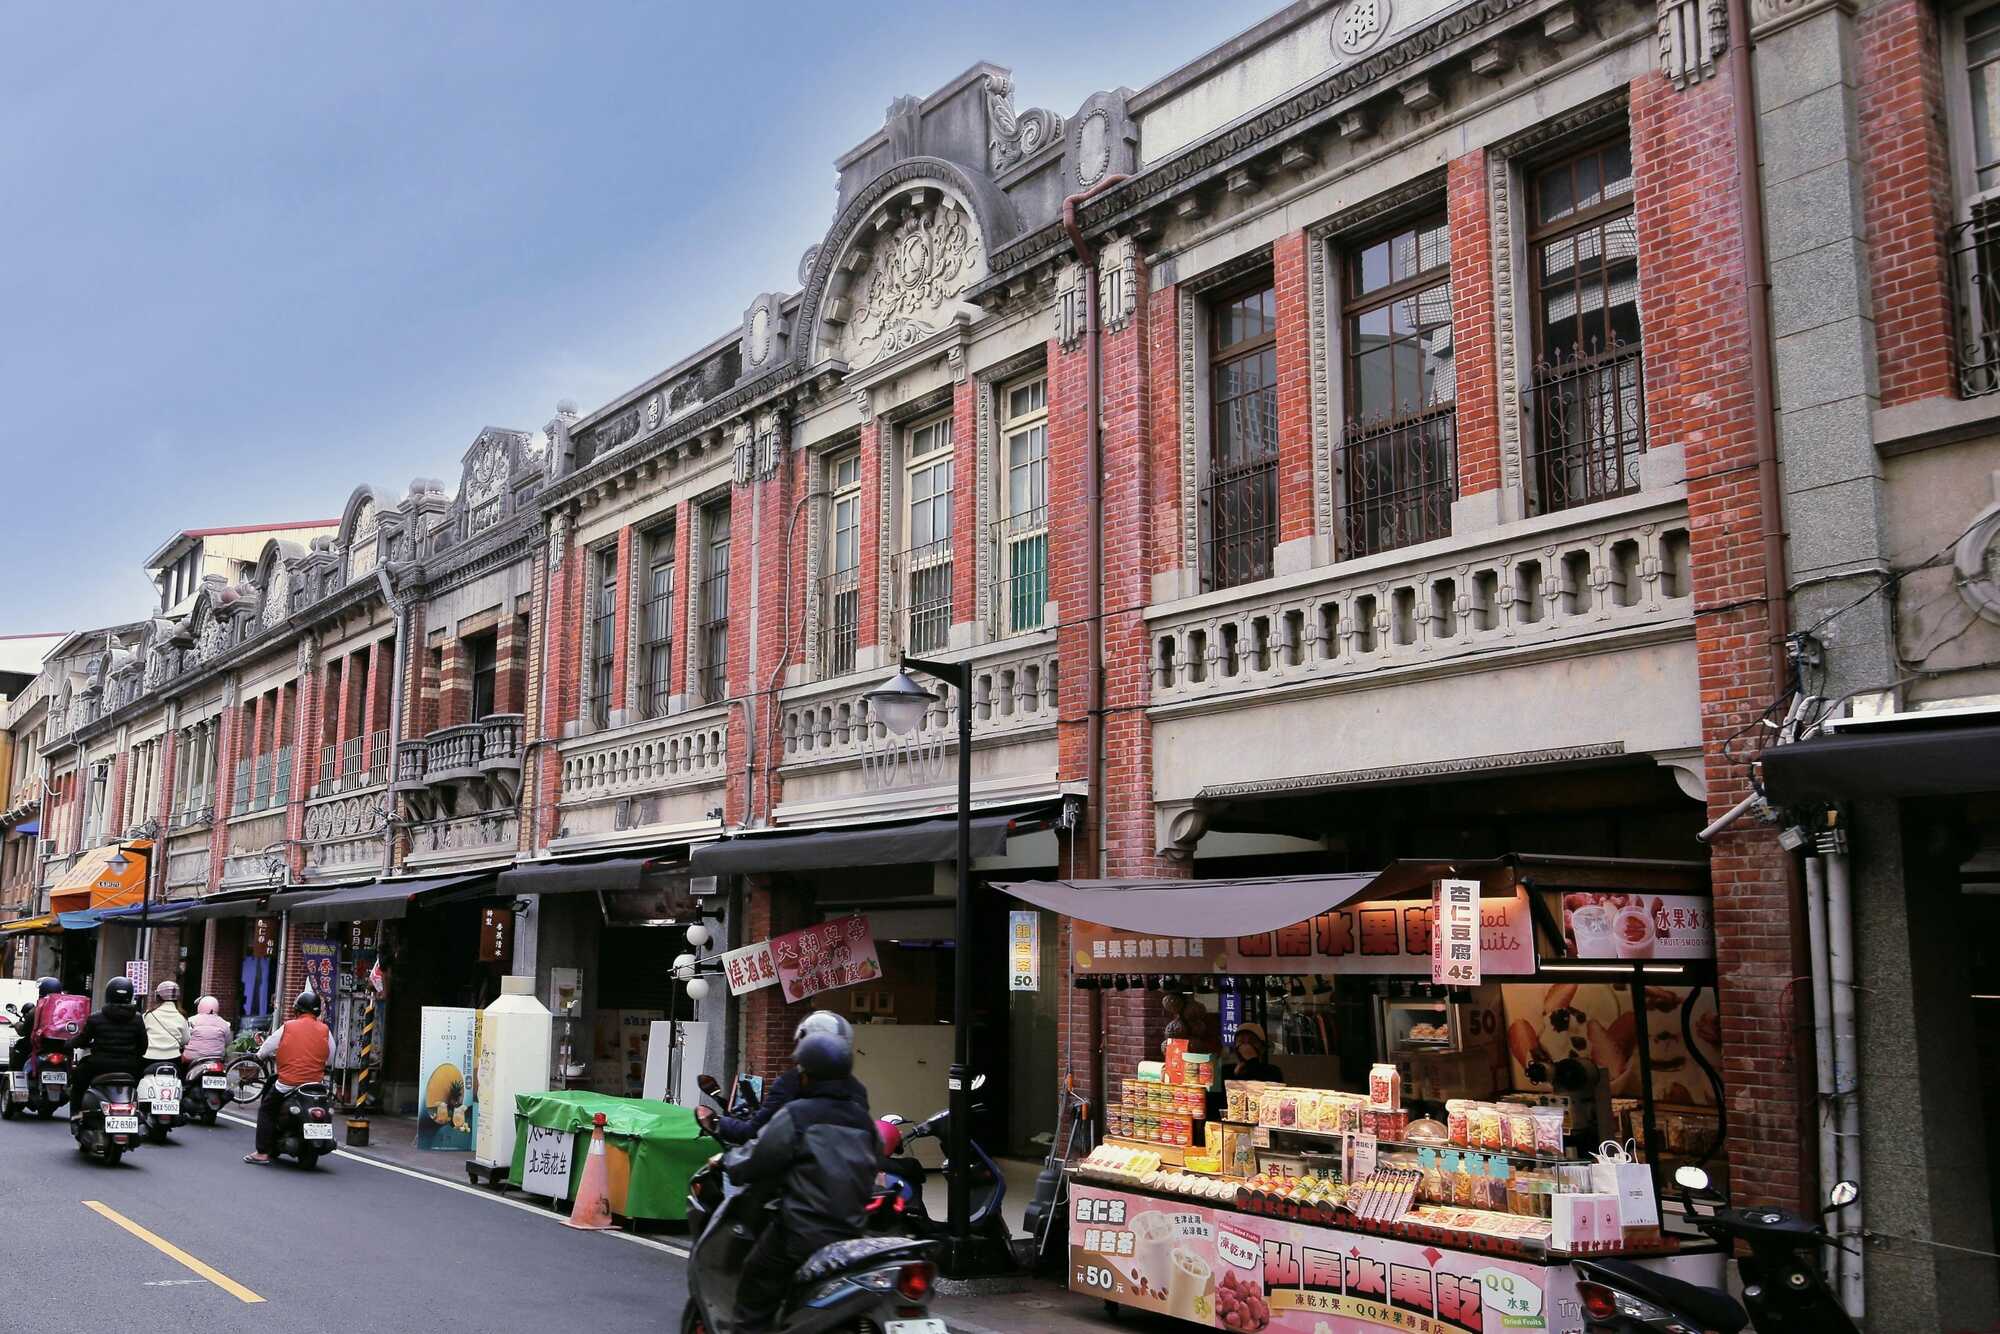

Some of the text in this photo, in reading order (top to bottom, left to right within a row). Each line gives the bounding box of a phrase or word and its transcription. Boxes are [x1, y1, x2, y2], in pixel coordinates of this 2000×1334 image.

[1450, 885, 1472, 961] 杏仁豆腐
[1480, 907, 1509, 928] ied
[1480, 932, 1520, 951] uits
[727, 950, 776, 989] 燒酒螺
[1014, 975, 1032, 986] 50
[1448, 965, 1473, 980] 45
[1469, 1009, 1496, 1034] 50
[529, 1147, 567, 1175] 北港花生
[1268, 1162, 1294, 1178] 杏仁
[1076, 1198, 1127, 1226] 杏仁茶
[1219, 1236, 1254, 1262] 凍乾水果
[1086, 1265, 1113, 1289] 50
[1115, 1282, 1125, 1294] 元
[1485, 1273, 1515, 1295] QQ
[1507, 1297, 1530, 1312] 水果
[1557, 1298, 1582, 1321] Try
[1503, 1318, 1522, 1326] Dried
